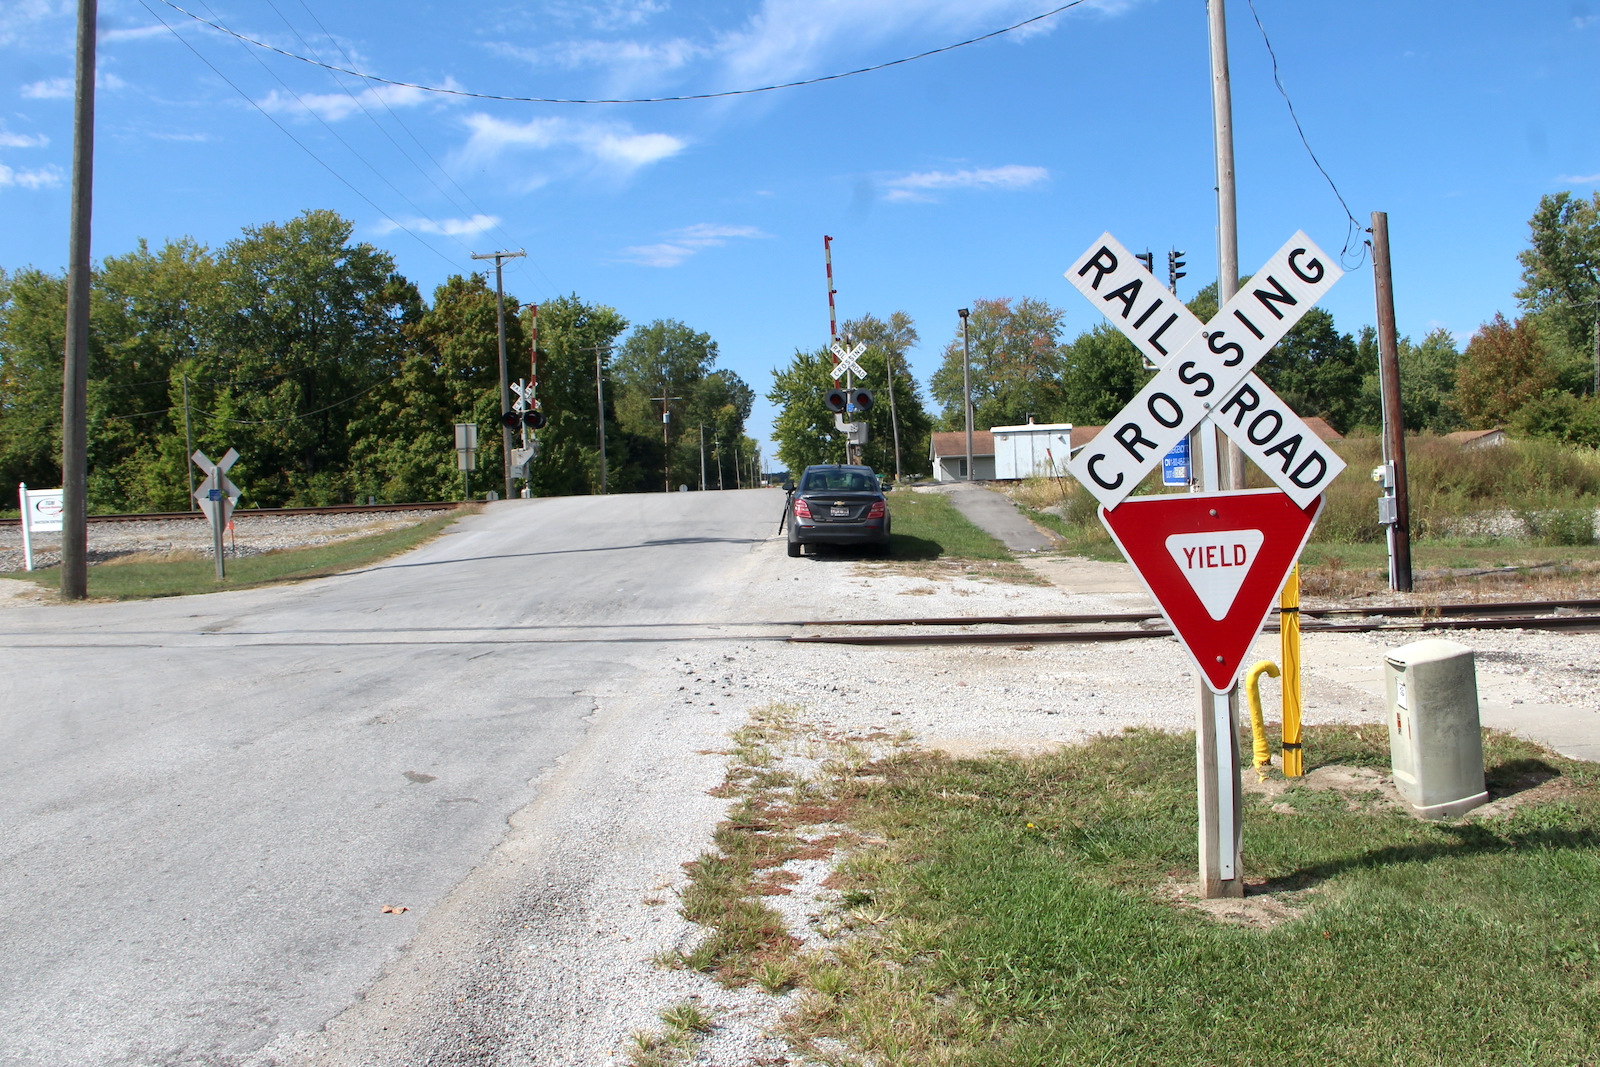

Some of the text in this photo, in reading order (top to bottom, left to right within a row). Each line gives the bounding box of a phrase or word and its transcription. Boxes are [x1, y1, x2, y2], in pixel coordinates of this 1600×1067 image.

[1078, 246, 1178, 356] RAIL
[832, 345, 845, 360] RAIL
[834, 345, 863, 377] CROSSING
[851, 363, 865, 378] ROAD
[1087, 248, 1324, 490] CROSSING
[1220, 383, 1327, 489] ROAD
[1183, 544, 1247, 570] YIELD
